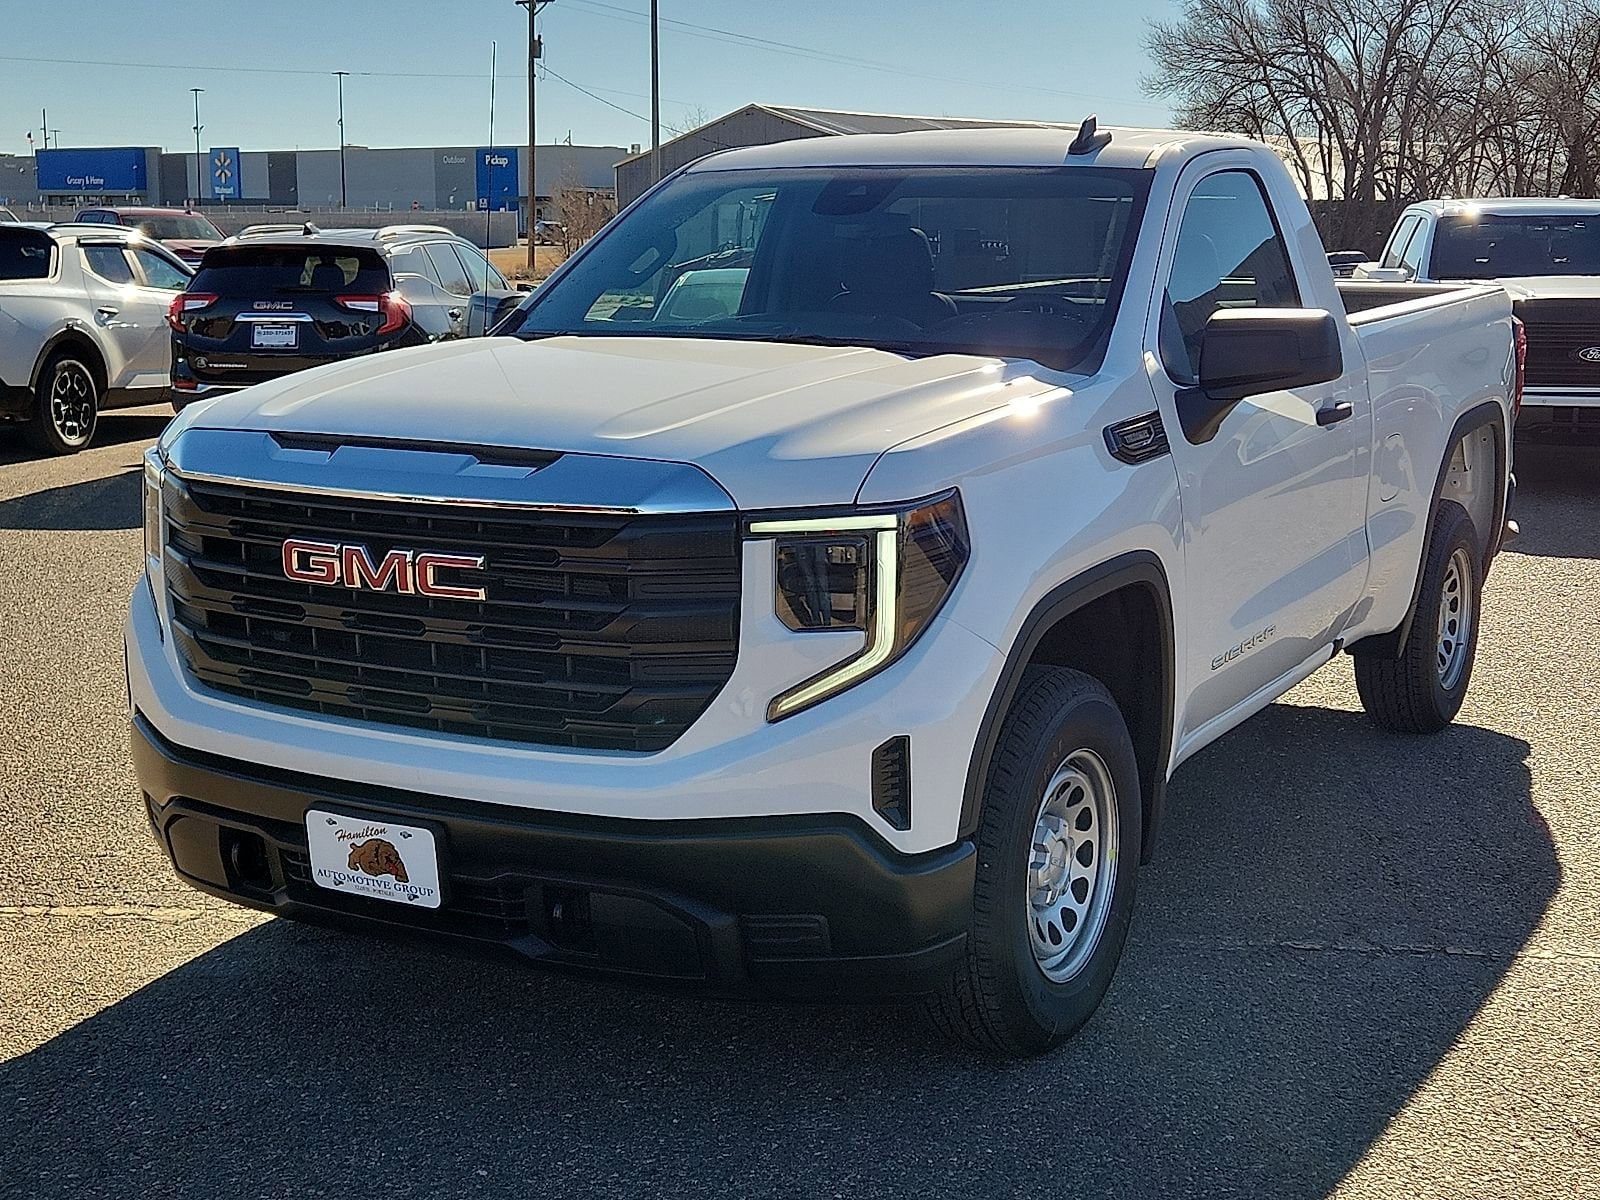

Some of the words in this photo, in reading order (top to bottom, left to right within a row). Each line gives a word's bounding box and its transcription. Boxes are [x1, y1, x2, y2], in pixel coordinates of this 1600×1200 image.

[485, 154, 508, 168] Pckup
[253, 301, 293, 309] GMC
[282, 538, 486, 601] GMC
[1211, 624, 1279, 671] SIERRA
[334, 825, 388, 842] Hamilton
[317, 868, 391, 890] AUTOMOTIVE
[394, 880, 434, 897] GROUP
